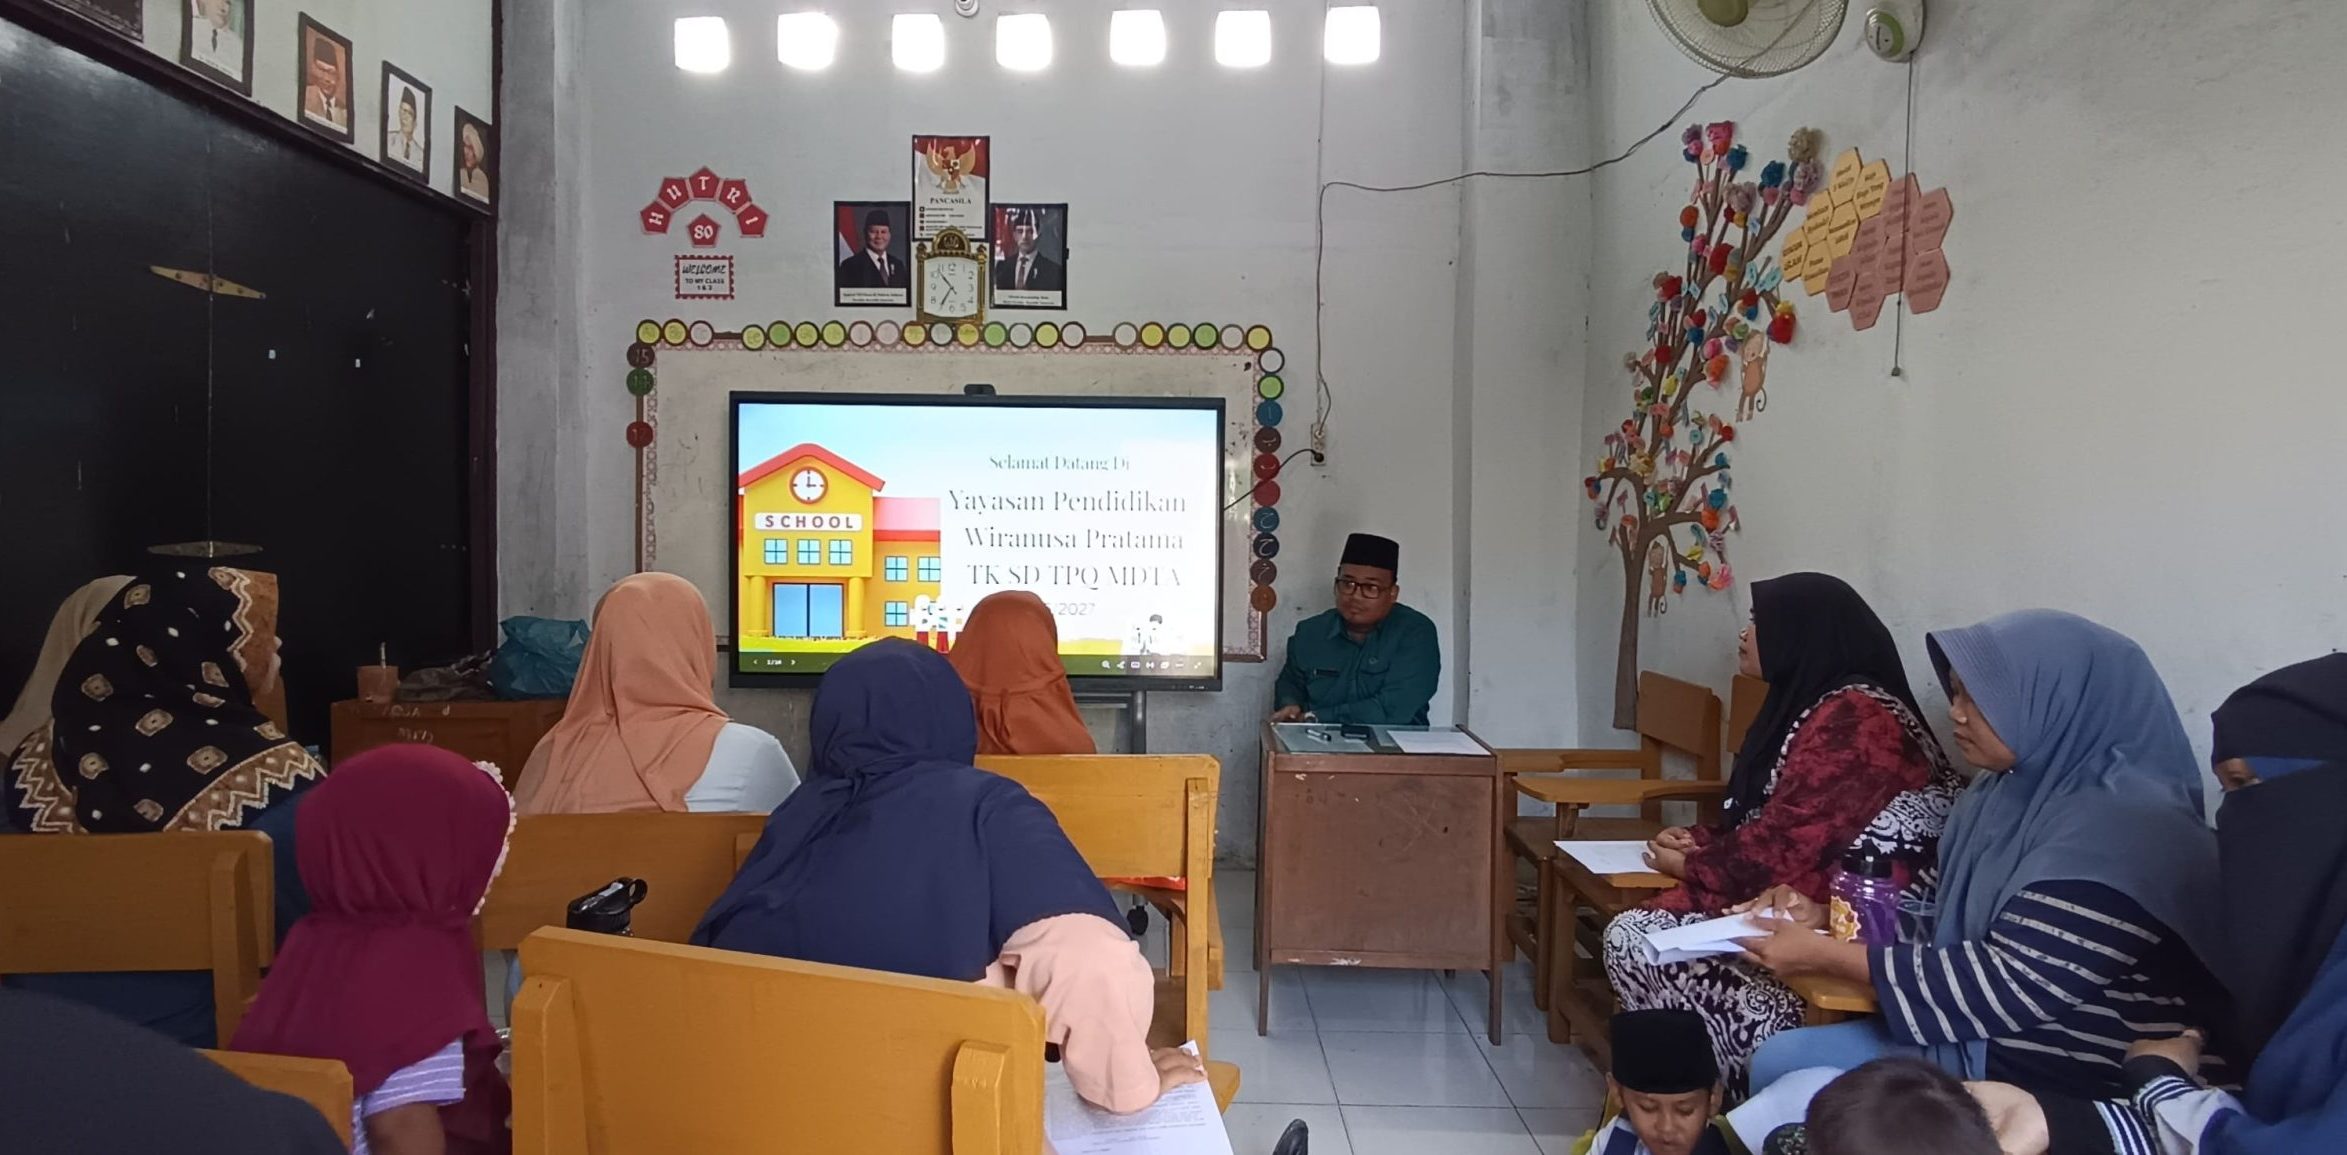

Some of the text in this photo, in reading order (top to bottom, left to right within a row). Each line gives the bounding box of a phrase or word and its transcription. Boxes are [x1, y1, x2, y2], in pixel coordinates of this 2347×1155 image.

[930, 197, 972, 205] PANCASILA
[694, 224, 714, 240] 80
[682, 264, 726, 275] WELCOME
[989, 454, 1130, 471] Selamat Datang Di
[949, 489, 1185, 515] Yayasan Pendidikan
[765, 515, 853, 529] SCHOOL
[965, 526, 1183, 549] Wiranusa Pratama
[967, 565, 1180, 590] TK SD TPQ MDTA
